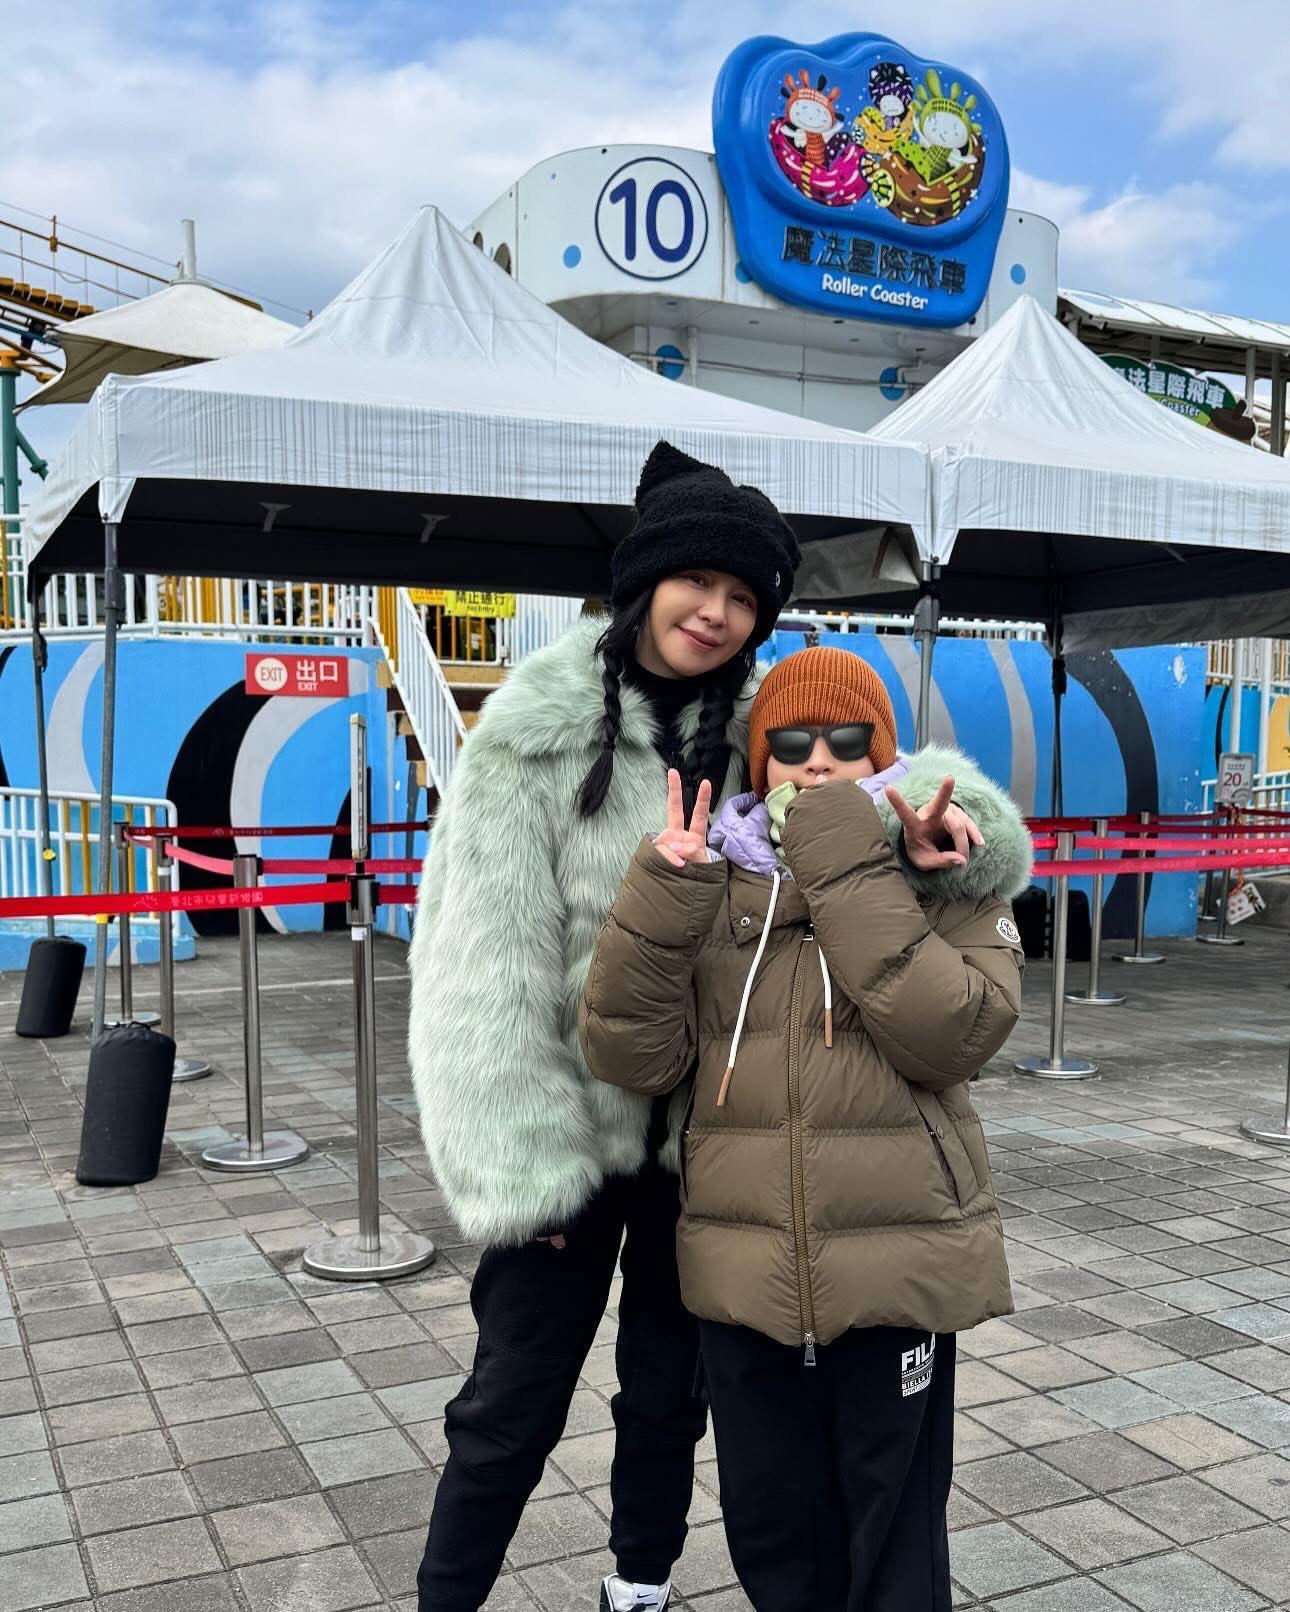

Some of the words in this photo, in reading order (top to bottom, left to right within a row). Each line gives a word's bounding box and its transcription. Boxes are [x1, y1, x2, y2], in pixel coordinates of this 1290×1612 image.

[609, 178, 694, 263] 10
[782, 226, 966, 294] 魔法星際飛車
[822, 273, 868, 298] Roller
[870, 284, 929, 310] Coaster
[261, 667, 283, 682] EXIT
[296, 659, 338, 682] 出口
[298, 682, 318, 692] EXIT
[1223, 772, 1242, 787] 20
